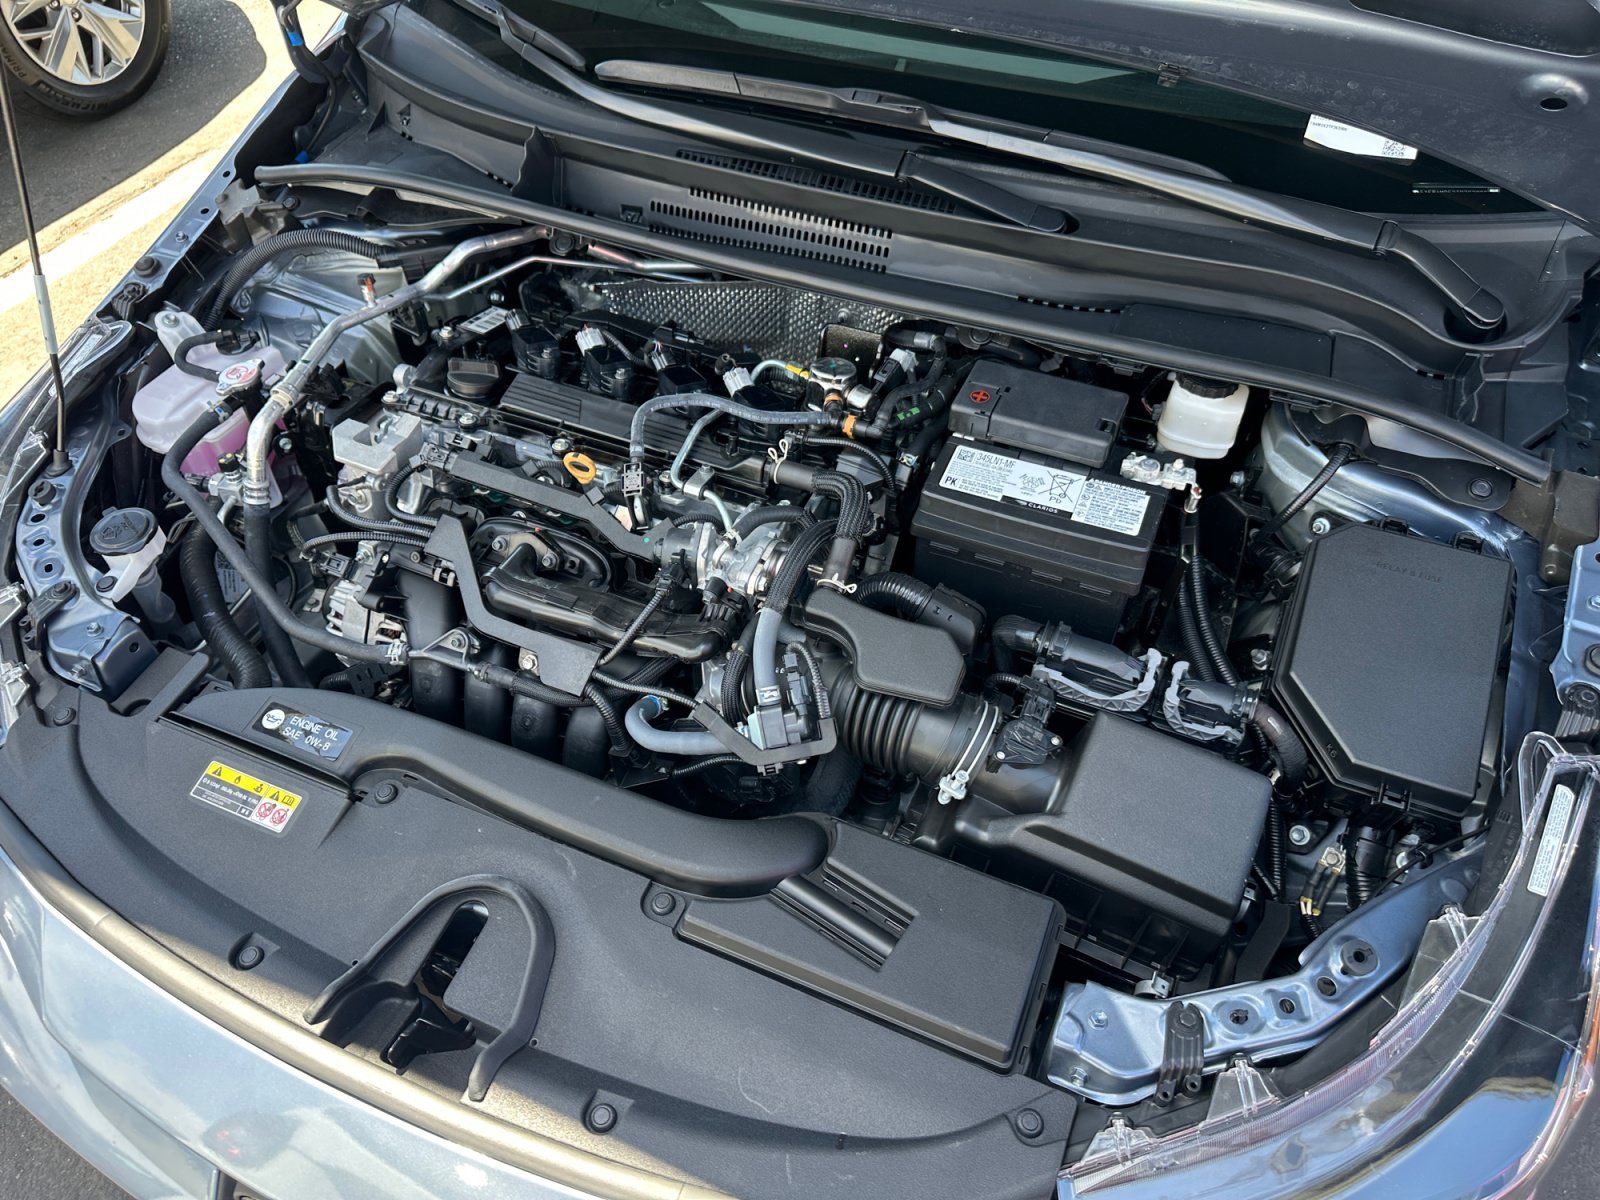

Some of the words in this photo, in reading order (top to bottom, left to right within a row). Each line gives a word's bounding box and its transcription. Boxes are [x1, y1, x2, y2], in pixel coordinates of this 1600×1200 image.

[0, 46, 27, 79] PRIMA
[944, 475, 958, 486] PK
[1028, 502, 1058, 514] CLARIOS
[282, 726, 303, 740] SAE
[304, 735, 331, 752] 0W-8
[290, 715, 322, 735] ENGINE
[324, 728, 339, 741] OIL
